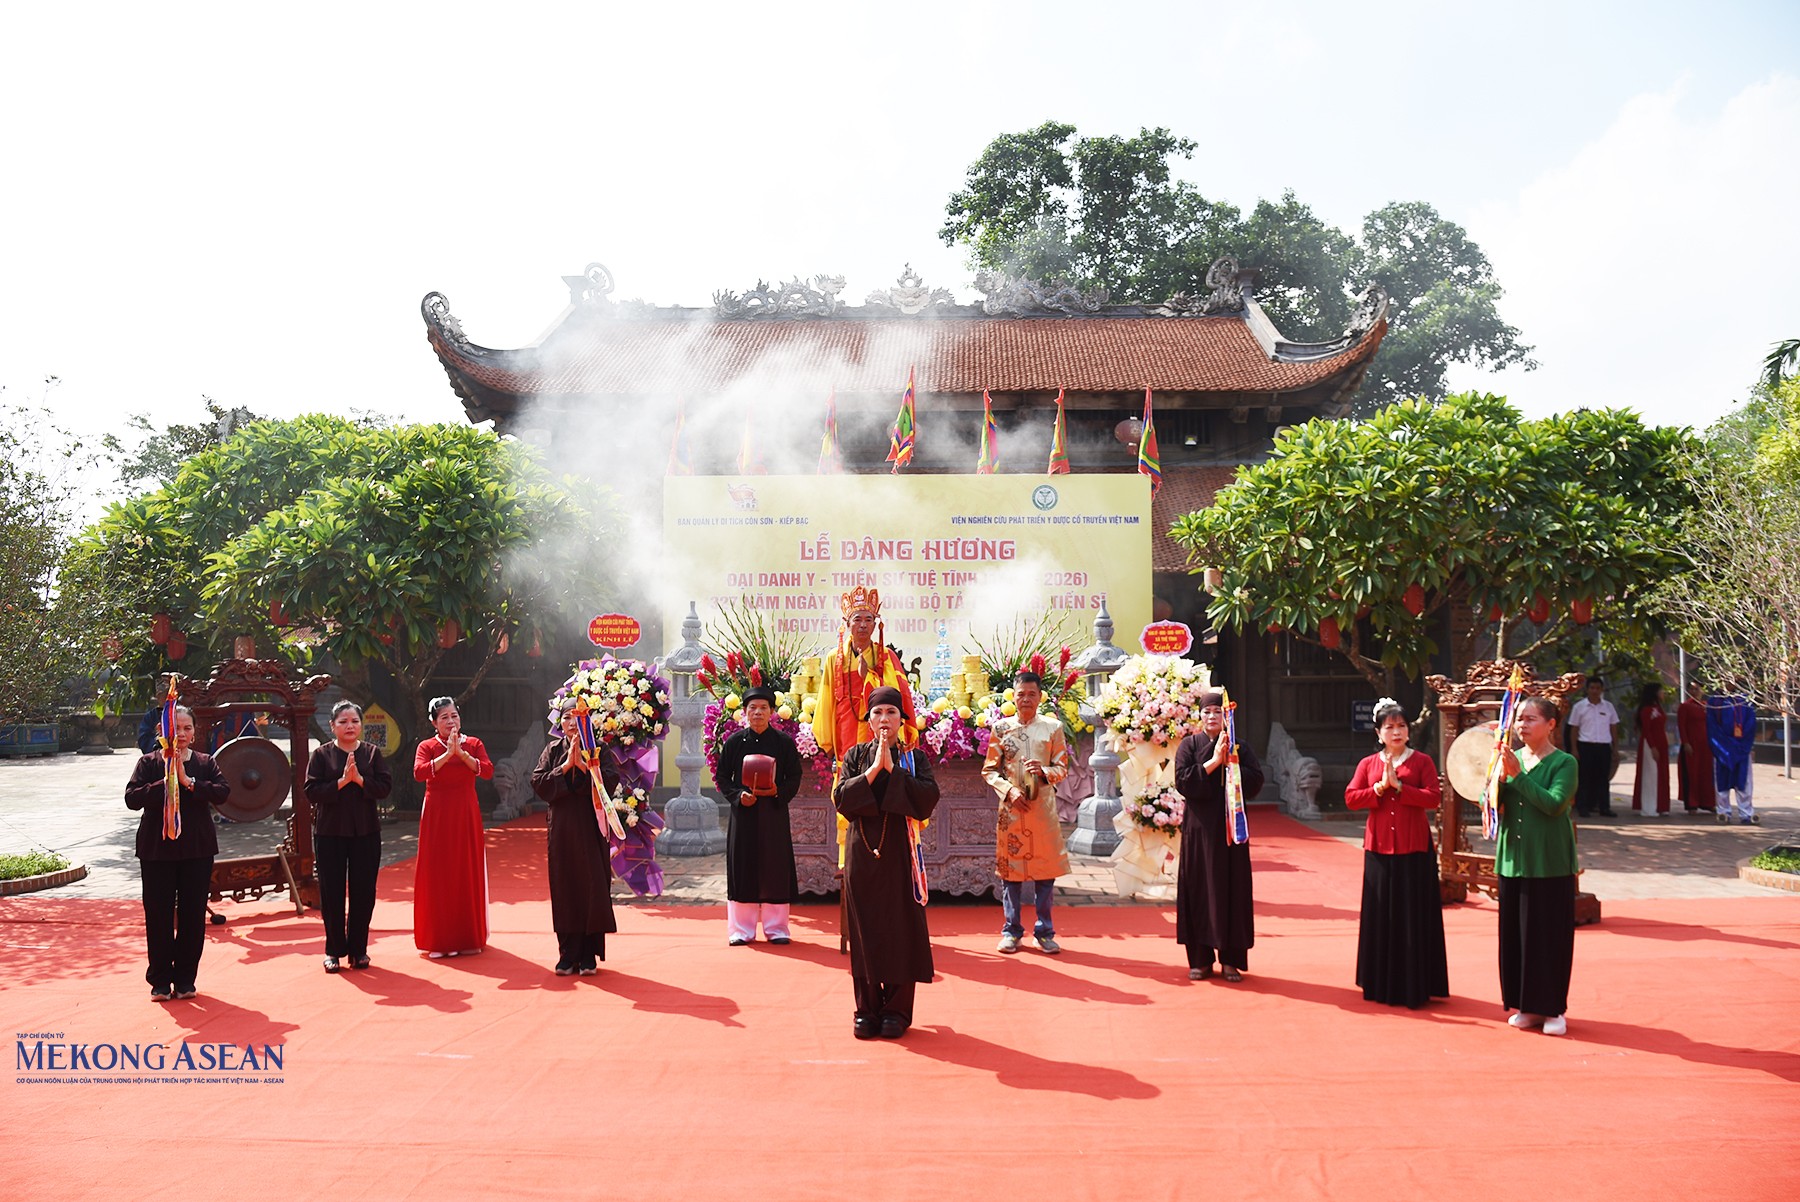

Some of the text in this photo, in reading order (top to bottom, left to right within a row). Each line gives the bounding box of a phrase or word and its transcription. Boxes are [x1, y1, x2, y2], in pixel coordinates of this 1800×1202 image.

[744, 516, 758, 525] CÔN
[760, 516, 774, 525] SƠN
[780, 514, 794, 525] KIẾP
[796, 517, 808, 526] BẠC
[952, 515, 966, 525] VIỆN
[968, 515, 992, 524] NGHIÊN
[1027, 514, 1046, 524] TRIỂN
[1053, 516, 1070, 525] DƯỢC
[1072, 514, 1081, 524] CỔ
[1082, 514, 1107, 524] TRUYỀN
[1108, 514, 1122, 525] VIỆT
[800, 532, 1015, 560] LỄ DÂNG HƯƠNG
[727, 572, 753, 590] ĐẠI
[758, 572, 800, 586] DANH
[806, 572, 816, 586] Y
[908, 569, 937, 590] TUỆ
[942, 570, 977, 586] TĨNH
[1044, 572, 1088, 587] 2026)
[743, 592, 780, 610] NĂM
[785, 592, 827, 610] NGÀY
[881, 593, 915, 609] ÔNG
[920, 593, 941, 612] BỘ
[946, 590, 964, 609] TẢ
[1052, 590, 1086, 609] TIẾN
[894, 618, 927, 632] NHO
